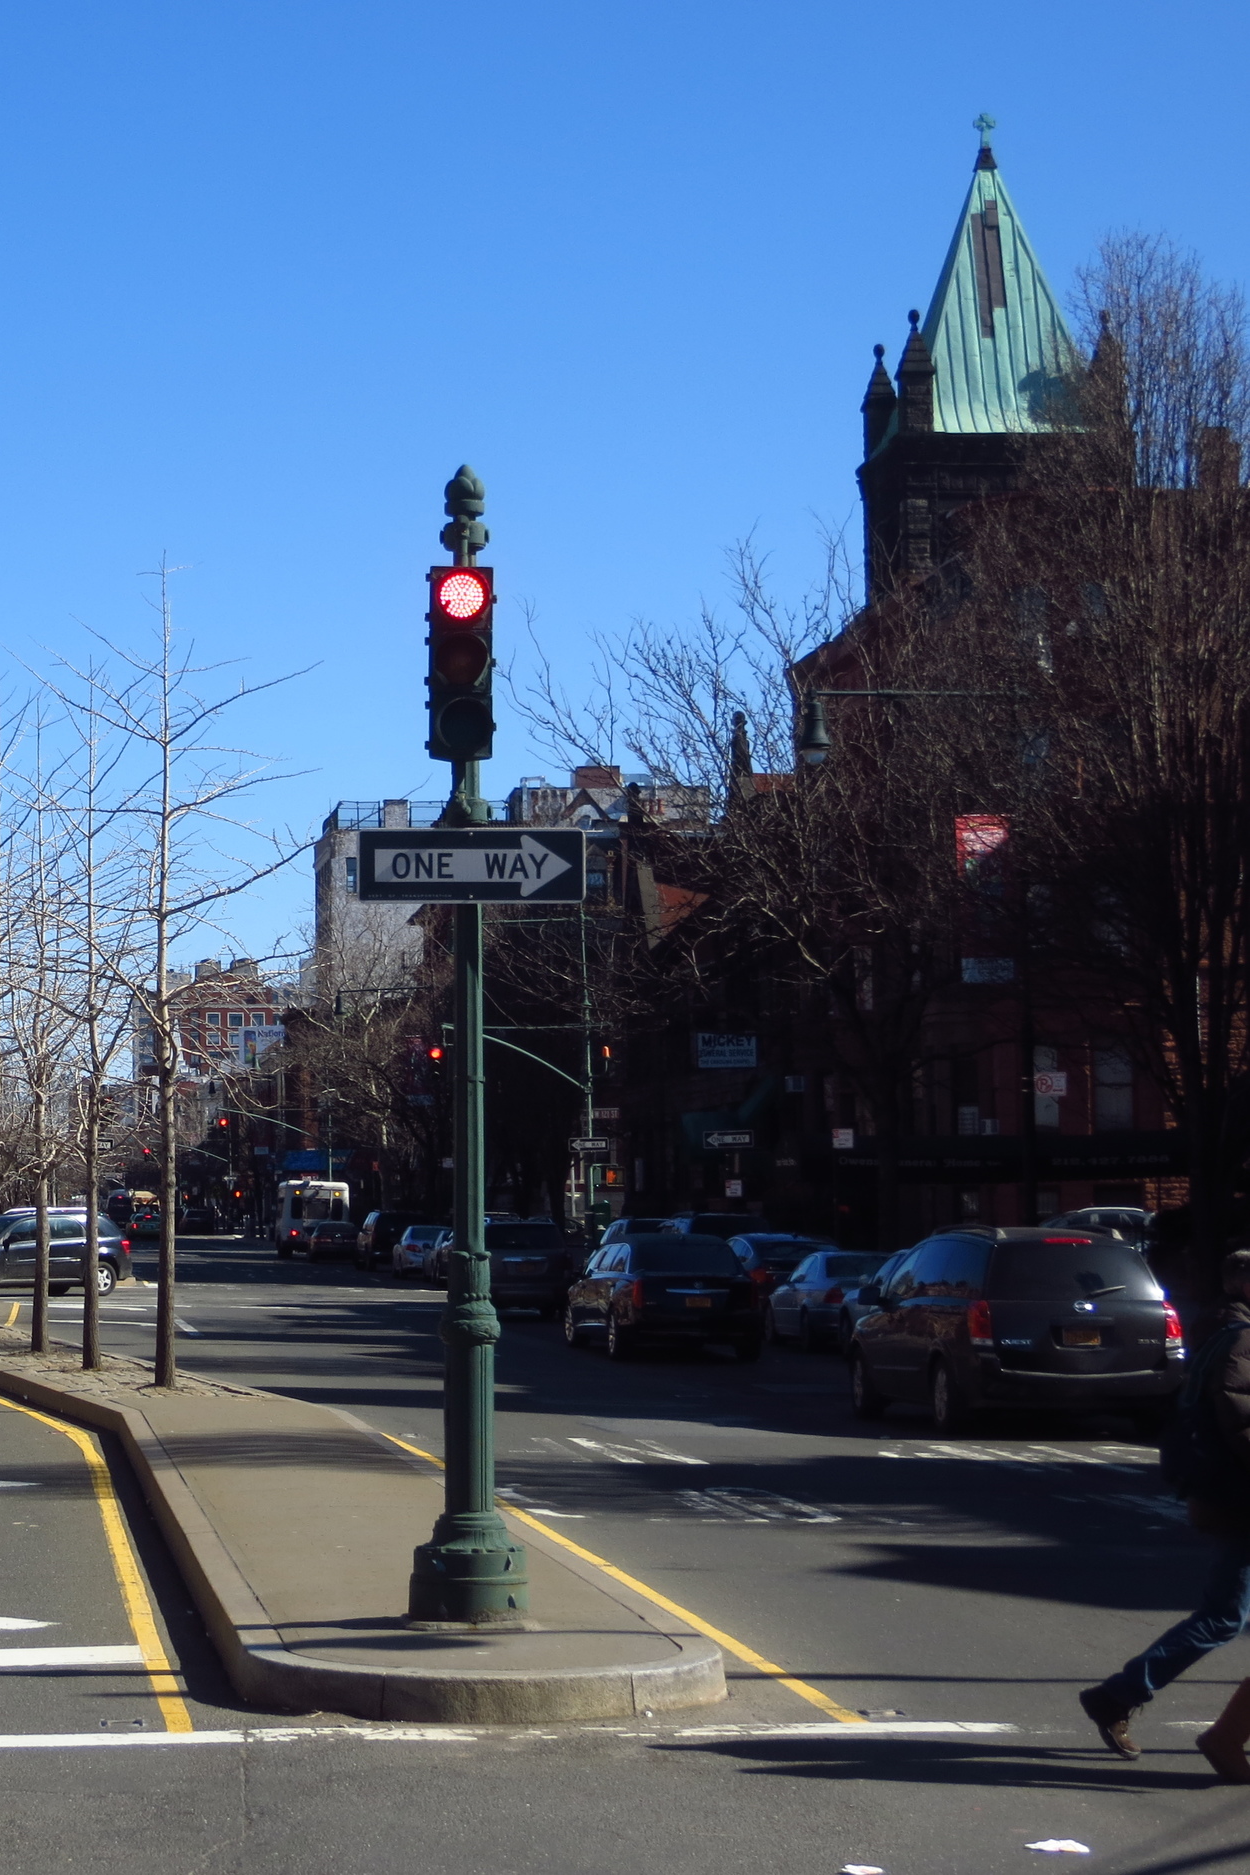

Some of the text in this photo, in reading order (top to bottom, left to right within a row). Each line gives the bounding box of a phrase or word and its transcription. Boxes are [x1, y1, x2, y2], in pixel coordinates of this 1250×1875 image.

[391, 852, 549, 880] ONE WAY
[701, 1034, 752, 1047] MICKEY
[699, 1048, 754, 1058] FUNERAL SERVICE
[594, 1110, 618, 1119] W 121 ST
[838, 1156, 879, 1166] Owens
[897, 1158, 937, 1167] uneral
[943, 1158, 982, 1168] Home
[1001, 1338, 1032, 1346] QUEST
